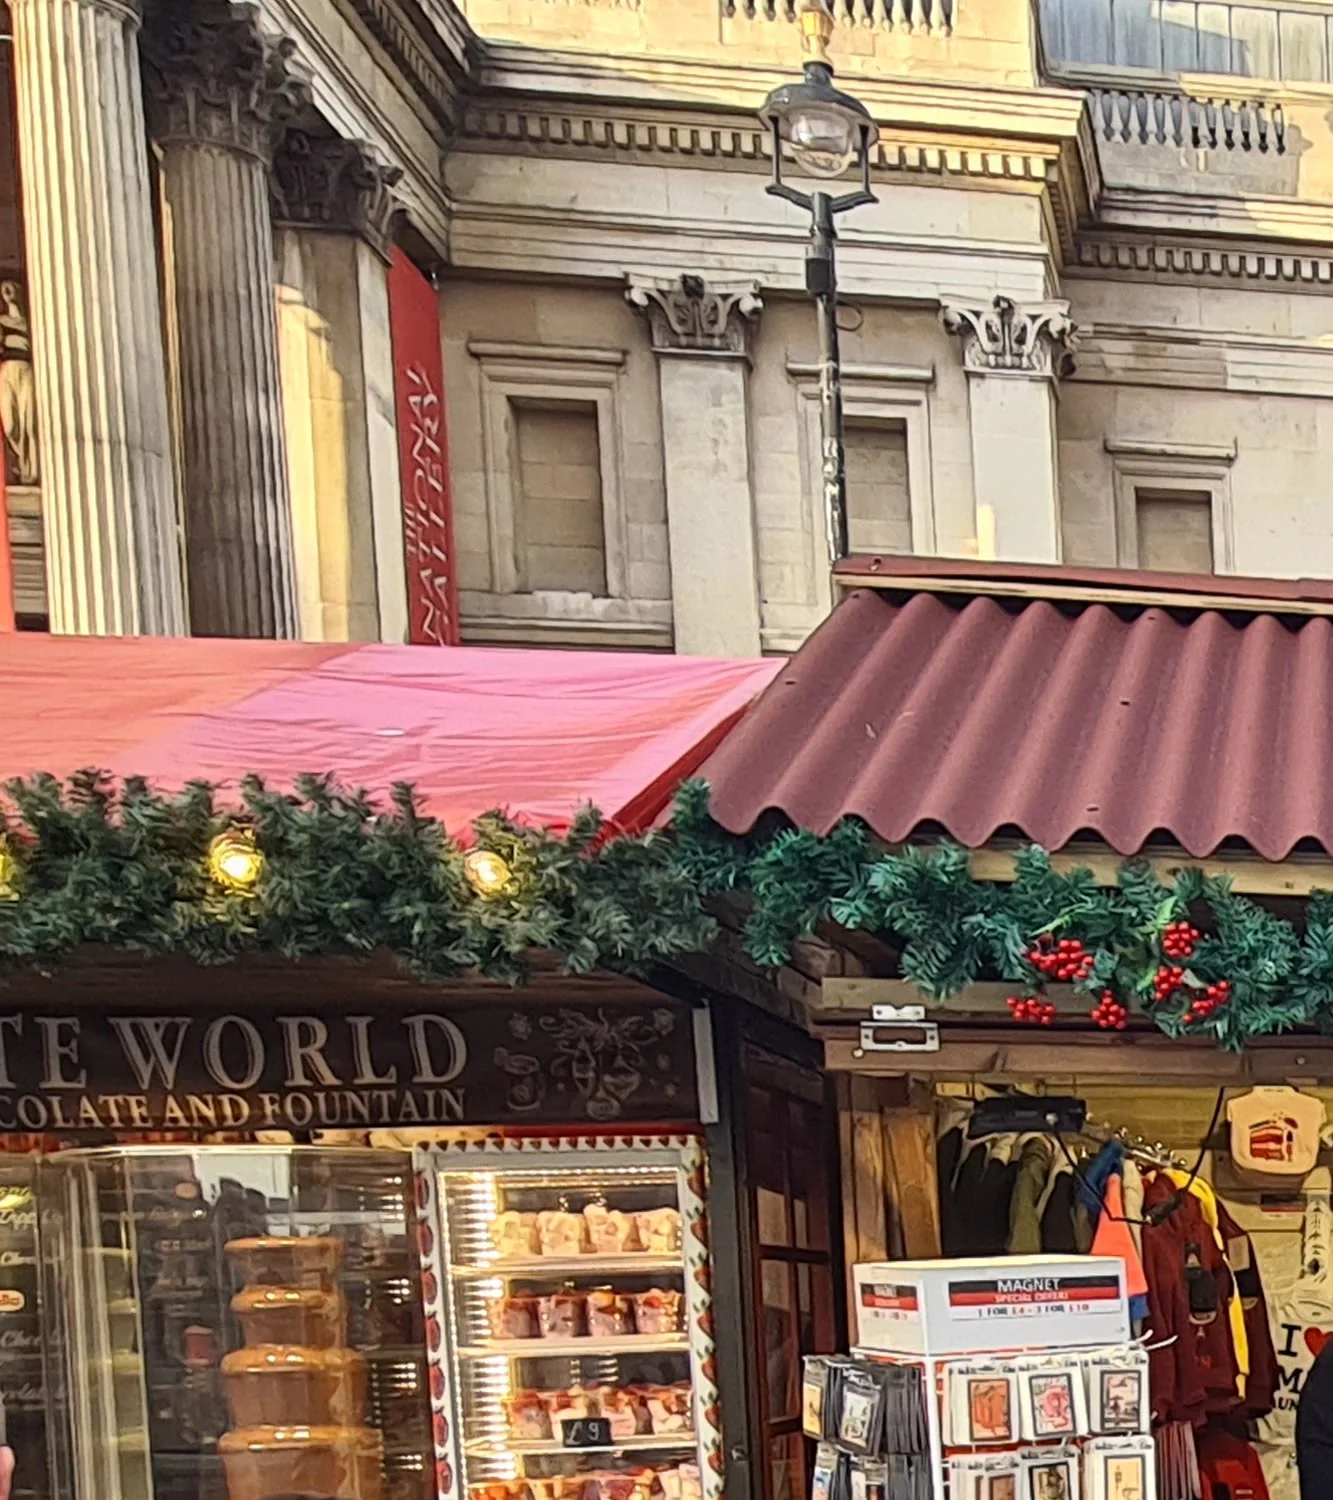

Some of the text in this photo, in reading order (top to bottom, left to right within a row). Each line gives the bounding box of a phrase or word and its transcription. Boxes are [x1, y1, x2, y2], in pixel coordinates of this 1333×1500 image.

[107, 1014, 467, 1090] WORLD
[163, 1093, 250, 1128] AND
[259, 1088, 465, 1126] FOUNTAIN
[997, 1277, 1061, 1293] MAGNET
[1277, 1323, 1302, 1357] I
